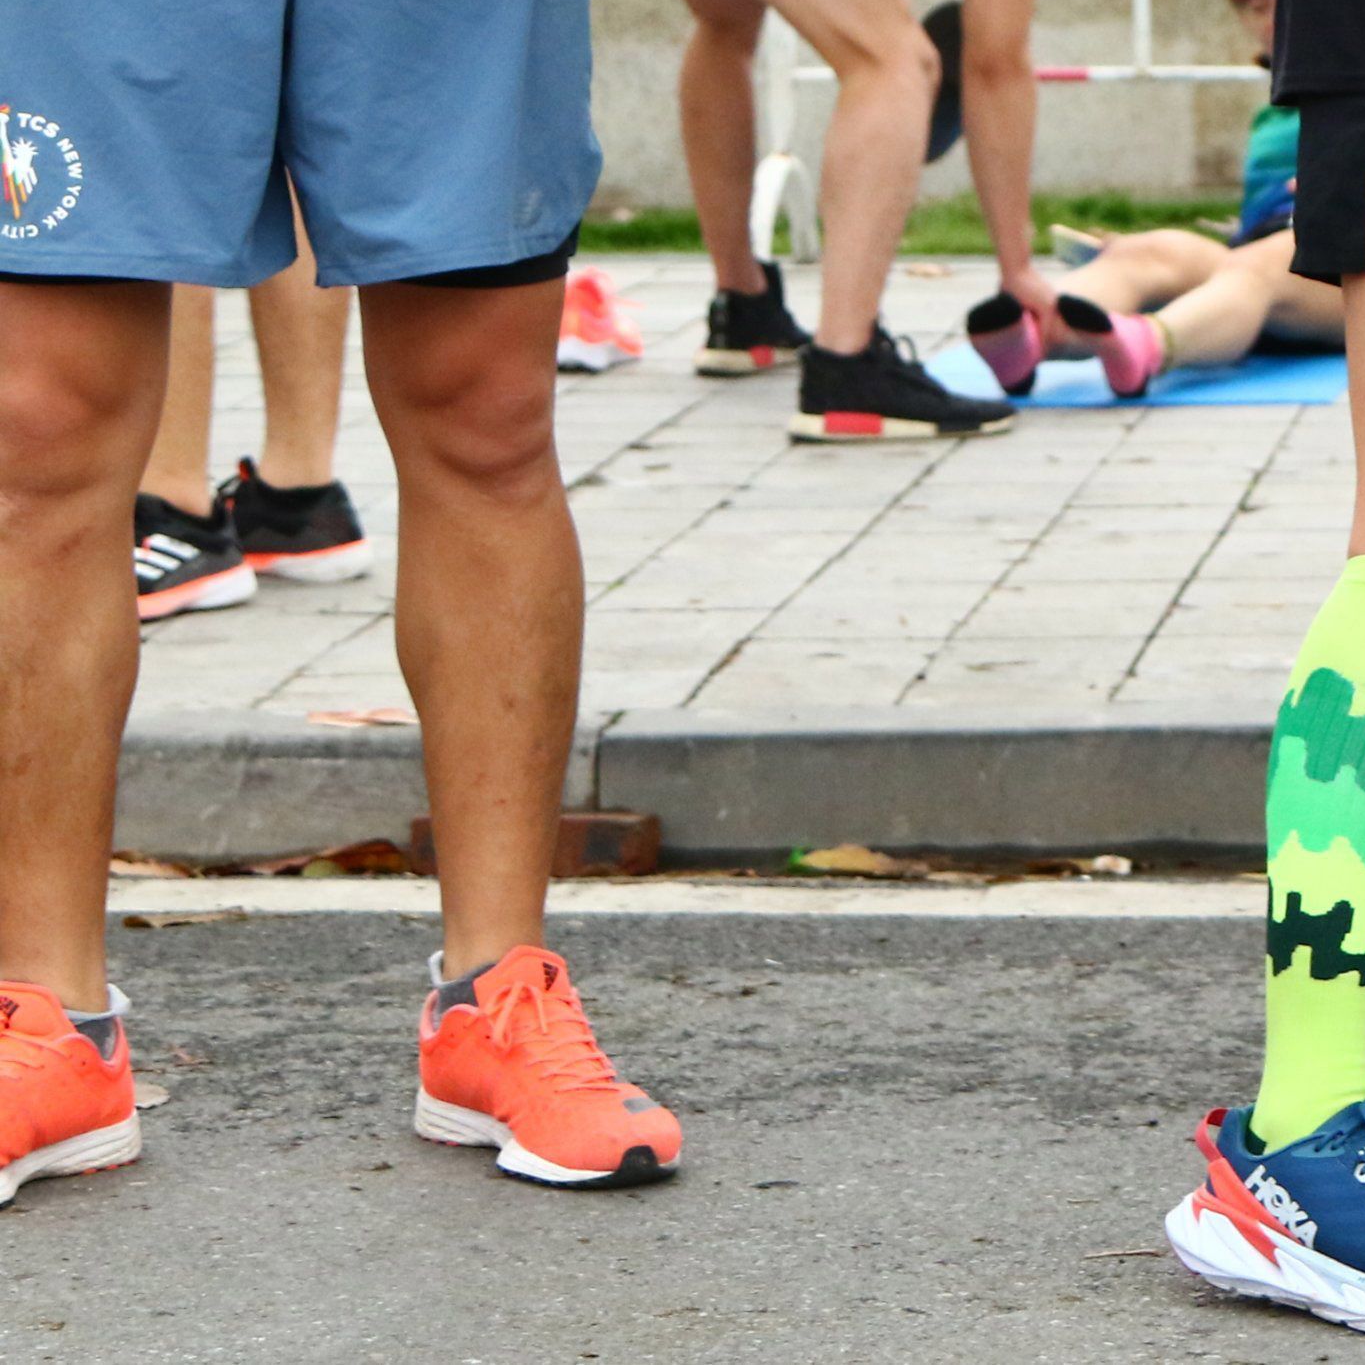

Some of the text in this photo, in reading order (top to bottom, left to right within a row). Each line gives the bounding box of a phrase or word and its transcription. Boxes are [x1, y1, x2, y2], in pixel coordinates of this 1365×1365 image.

[1, 112, 83, 239] TCS NEW YORK CITY
[1245, 1164, 1318, 1250] HOKA
